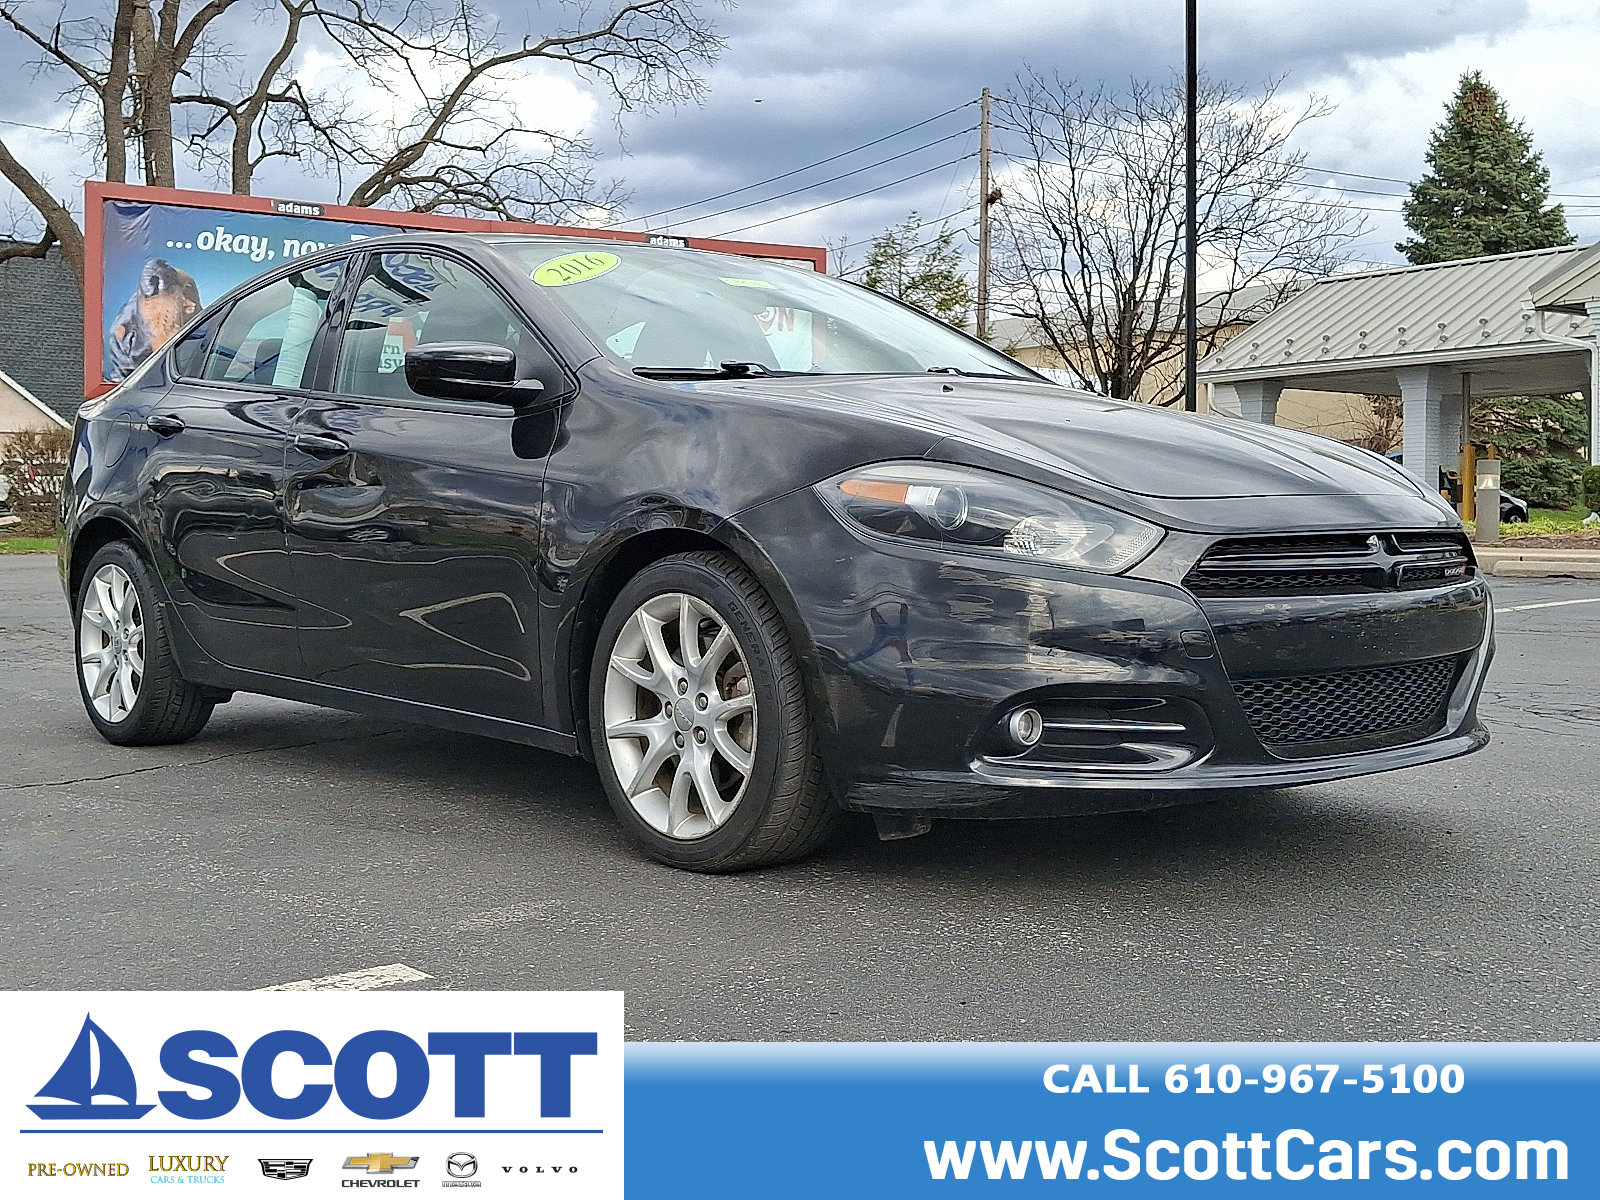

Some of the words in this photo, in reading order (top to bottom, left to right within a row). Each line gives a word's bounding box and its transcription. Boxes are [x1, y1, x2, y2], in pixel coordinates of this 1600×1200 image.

[276, 202, 321, 217] adams
[649, 235, 686, 248] adams
[546, 254, 606, 282] 2016
